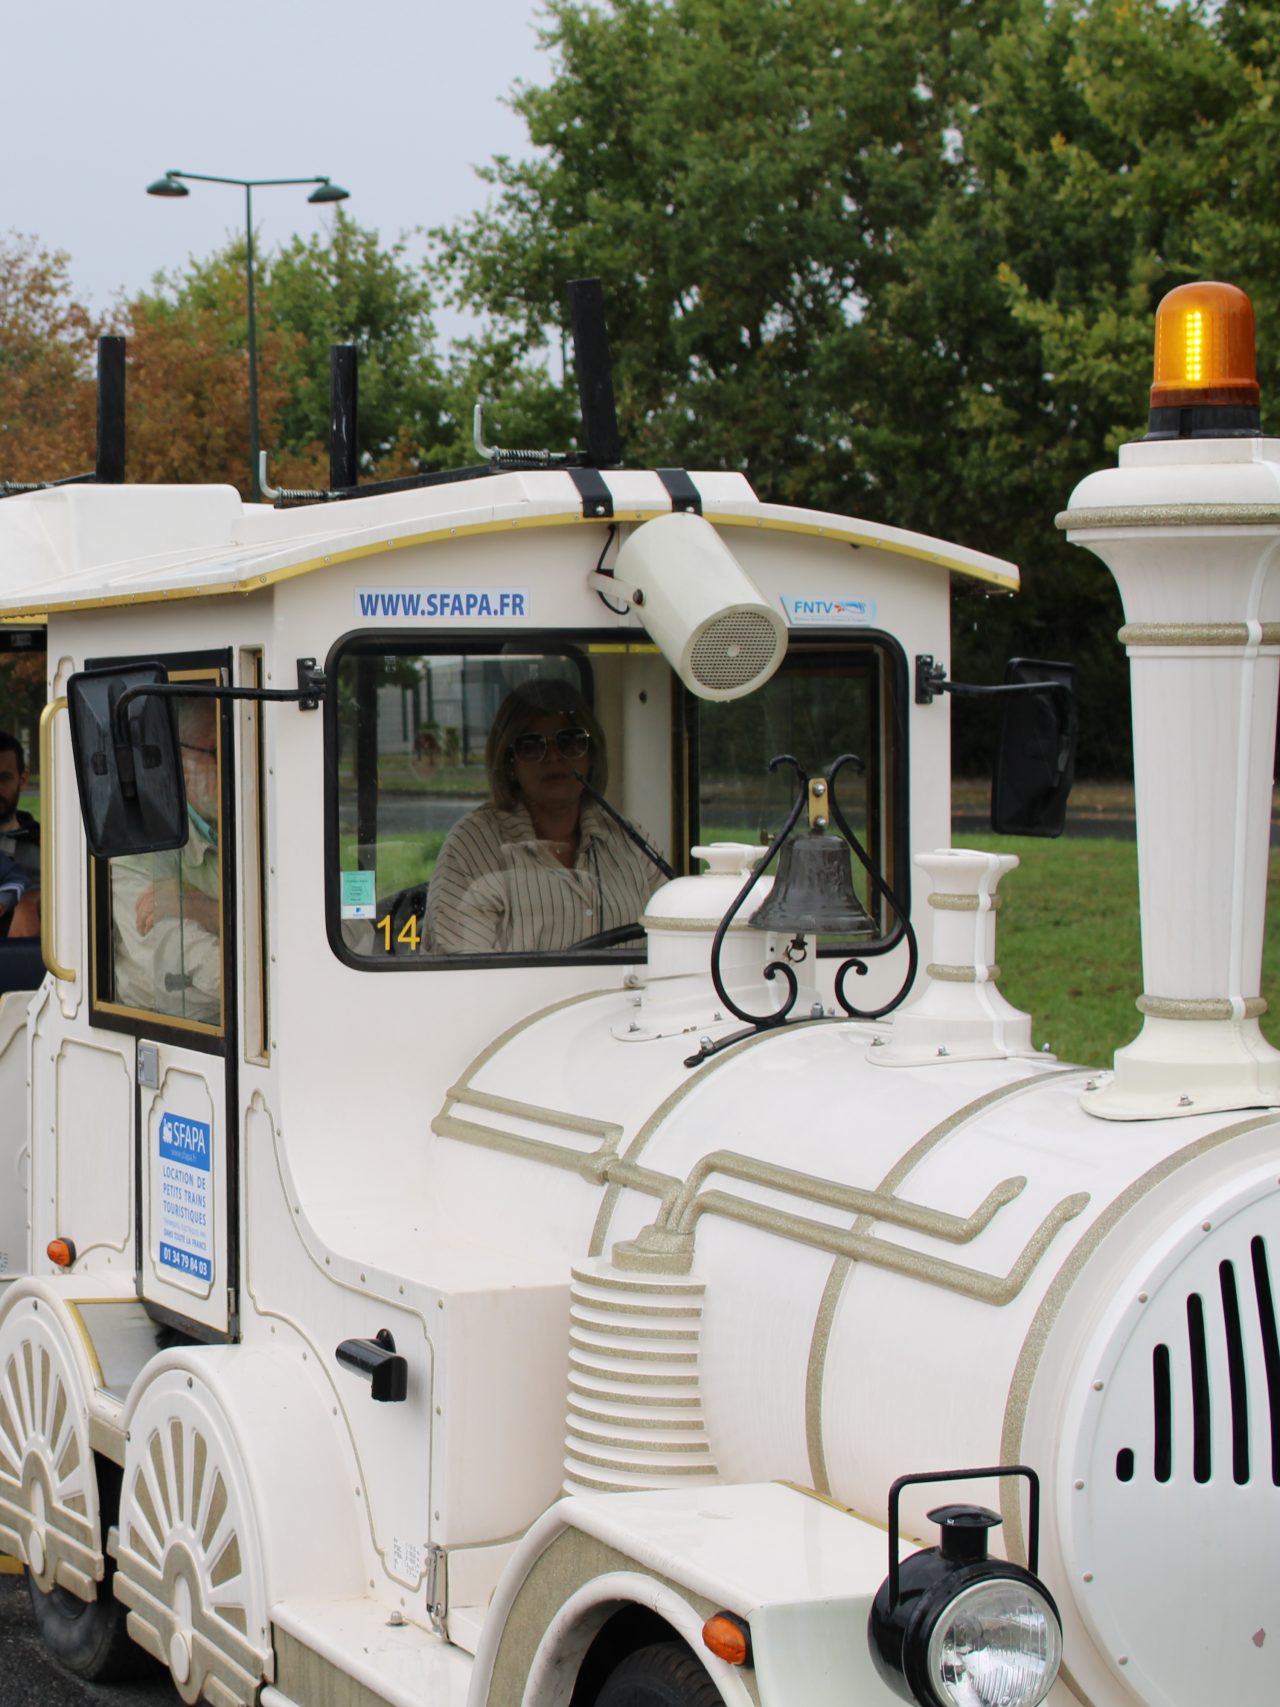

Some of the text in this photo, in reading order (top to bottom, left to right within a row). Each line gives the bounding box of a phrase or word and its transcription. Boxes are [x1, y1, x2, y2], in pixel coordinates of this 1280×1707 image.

[359, 593, 525, 617] WWW.SFAPA.FR
[794, 600, 834, 614] FNTV
[377, 914, 420, 951] 14
[173, 1122, 206, 1154] SFAPA
[163, 1165, 206, 1190] LOCATION DE
[163, 1182, 206, 1208] PETITS TRAINS
[163, 1200, 206, 1226] TOURISTIQUES
[163, 1247, 171, 1261] 01
[172, 1250, 180, 1265] 34
[181, 1253, 189, 1268] 79
[199, 1260, 207, 1276] 03
